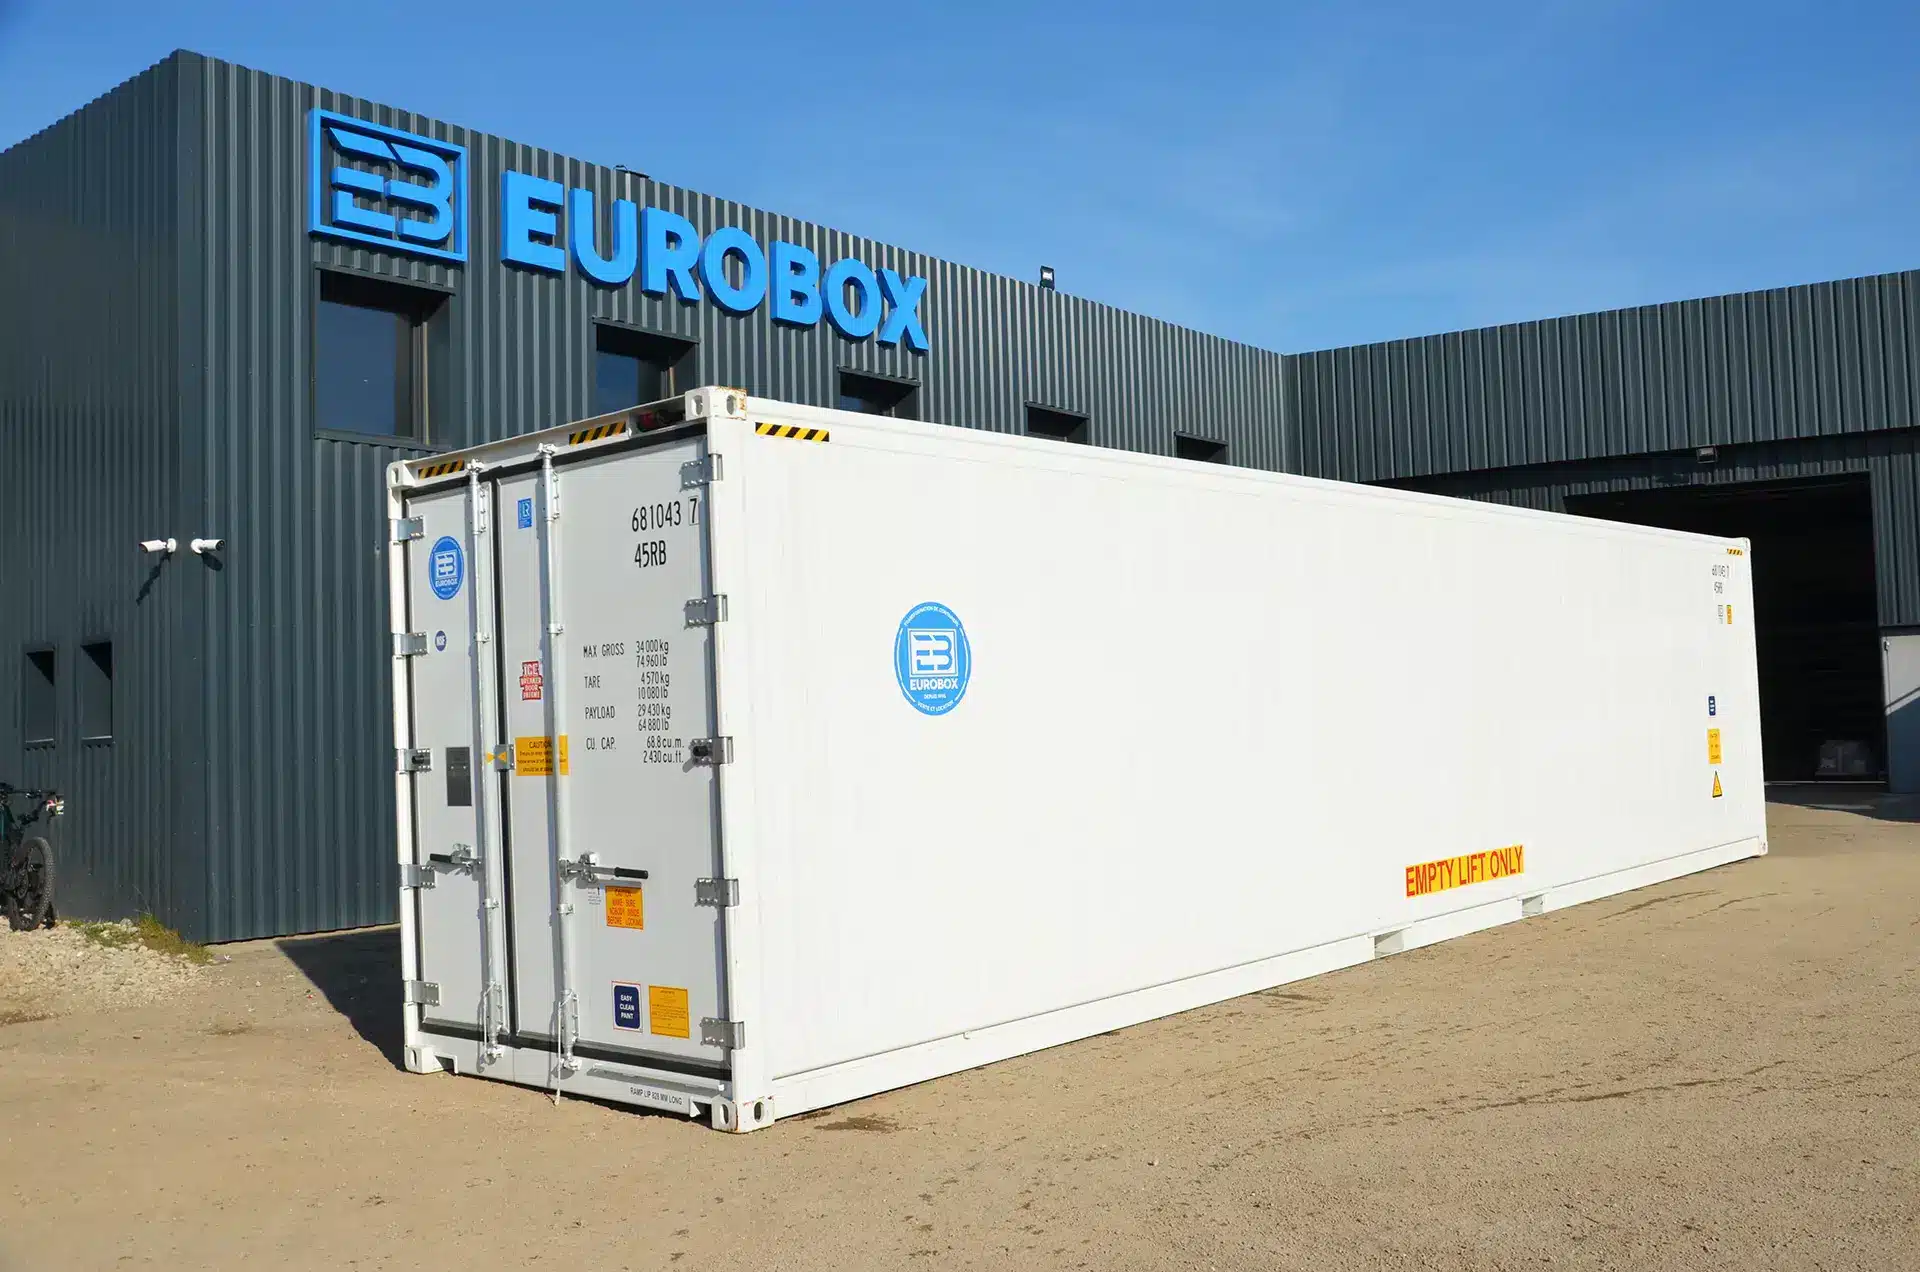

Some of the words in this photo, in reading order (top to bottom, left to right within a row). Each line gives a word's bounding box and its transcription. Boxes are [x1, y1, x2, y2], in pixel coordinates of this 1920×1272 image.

[501, 170, 930, 352] EUROBOX
[631, 500, 682, 532] 681043
[689, 498, 698, 523] 7
[634, 540, 667, 568] 45RB
[435, 578, 458, 588] EUROBOX
[583, 644, 598, 658] MAX
[601, 643, 625, 656] GROSS
[523, 663, 538, 676] ICE
[584, 675, 601, 688] TARE
[910, 678, 958, 691] EUROBOX
[585, 706, 616, 719] PAYLOAD
[586, 737, 598, 750] CU.
[601, 737, 617, 750] CAP.
[1406, 858, 1454, 897] EMPTY
[1458, 852, 1486, 886] LIFT
[1490, 845, 1523, 878] ONLY
[620, 994, 632, 1002] EASY
[619, 1003, 635, 1011] CLEAN
[620, 1012, 634, 1020] PAINT
[630, 1086, 643, 1096] RAMP
[668, 1095, 683, 1105] LONG
